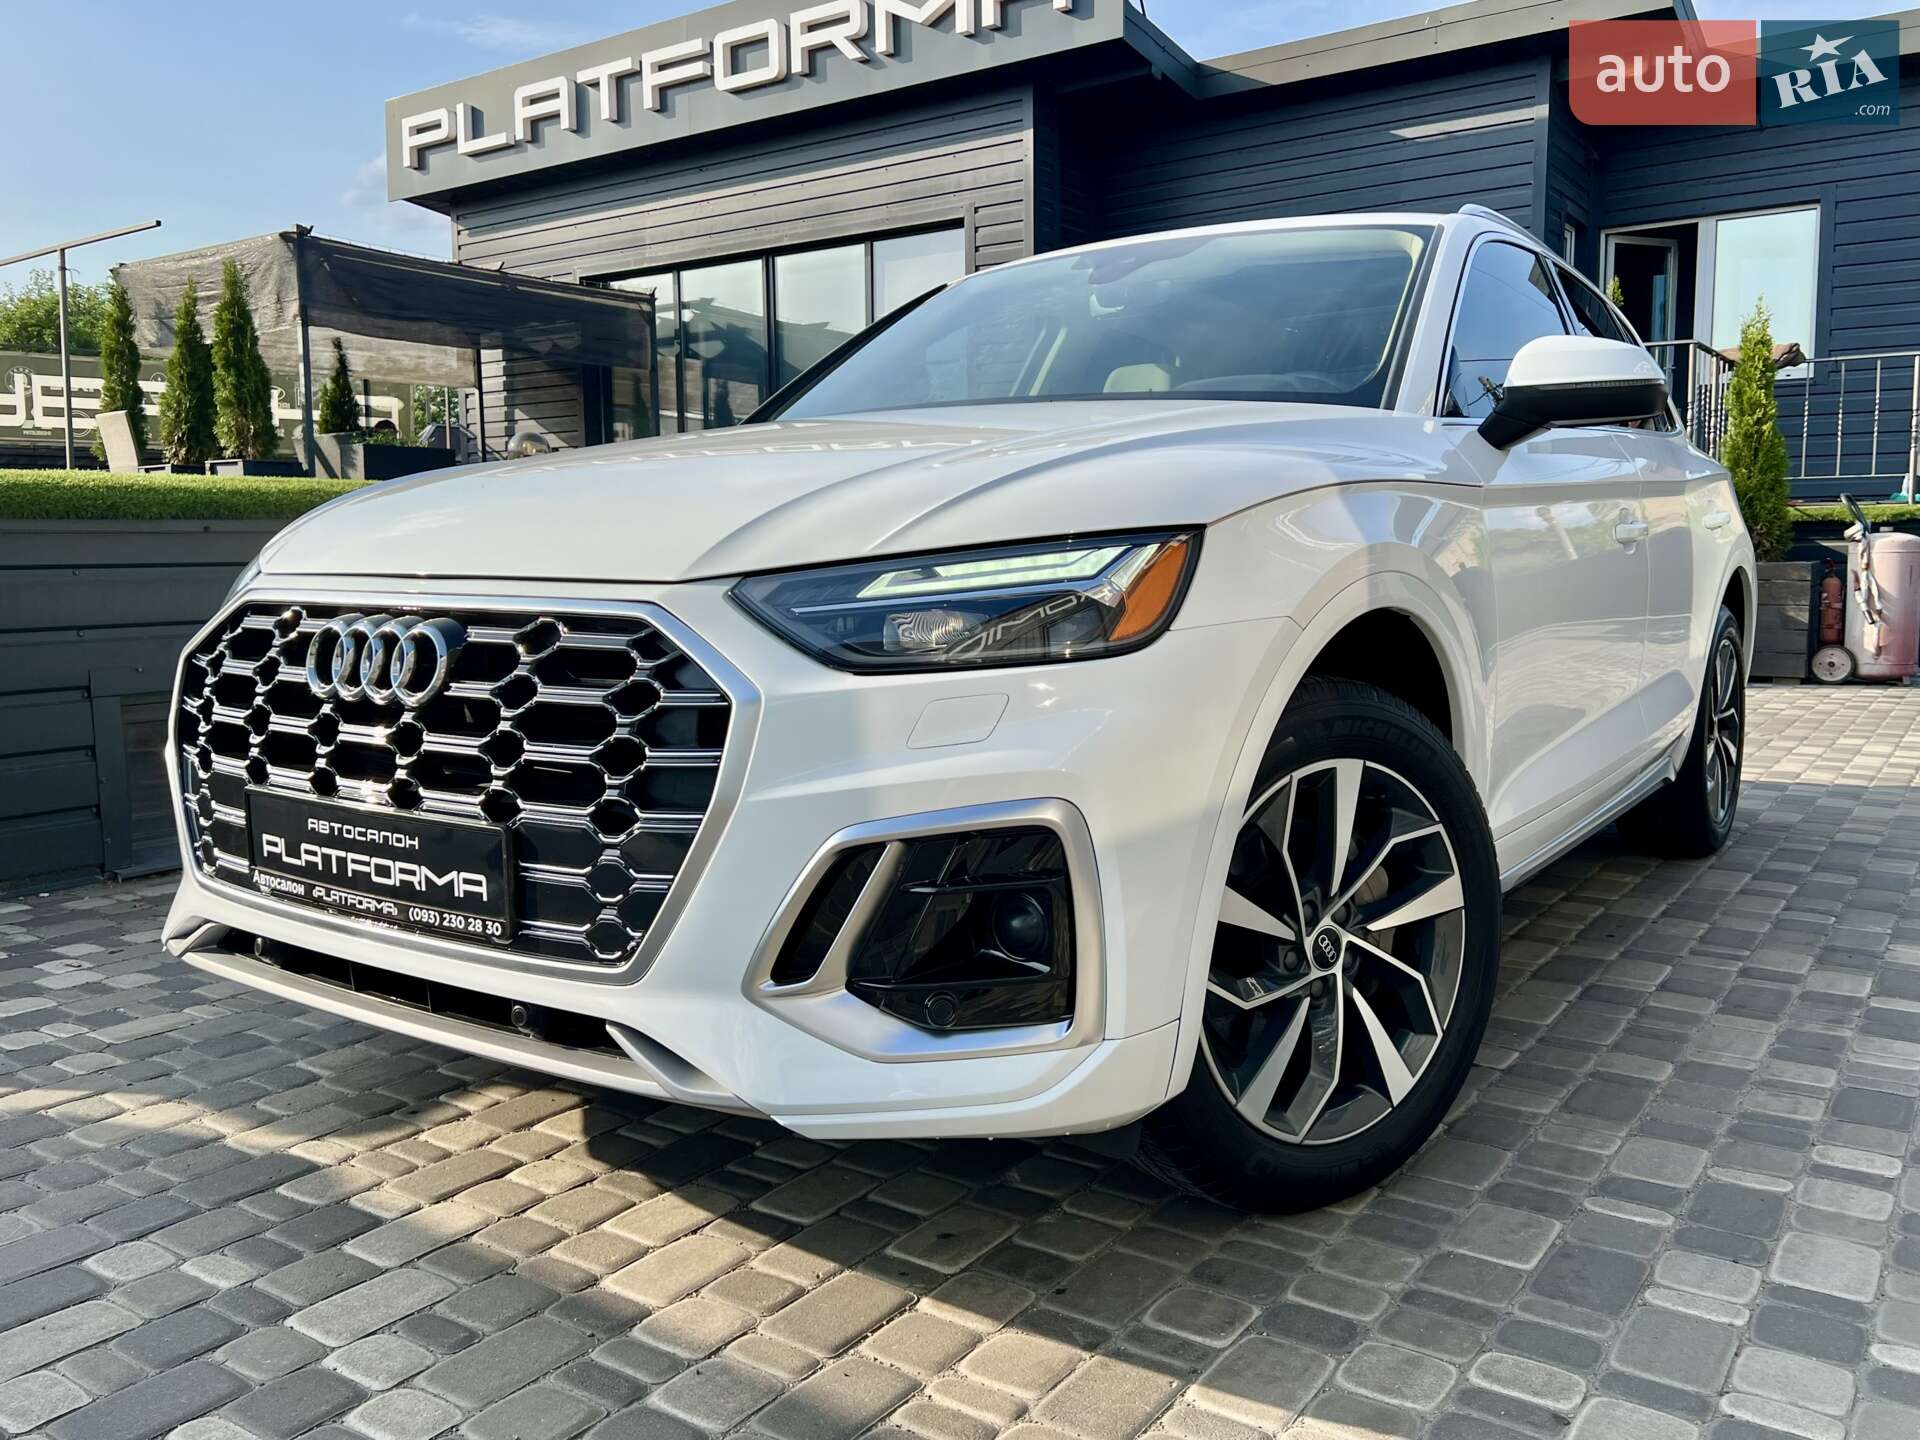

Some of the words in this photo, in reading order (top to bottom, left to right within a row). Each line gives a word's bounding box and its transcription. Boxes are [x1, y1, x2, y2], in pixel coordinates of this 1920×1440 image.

[307, 817, 419, 850] АВТОСАЛОН
[262, 833, 488, 902] PLATFORMA
[252, 869, 305, 896] Автосалон
[408, 907, 440, 927] (093)
[442, 913, 465, 929] 230
[467, 917, 483, 933] 28
[485, 921, 502, 936] 30
